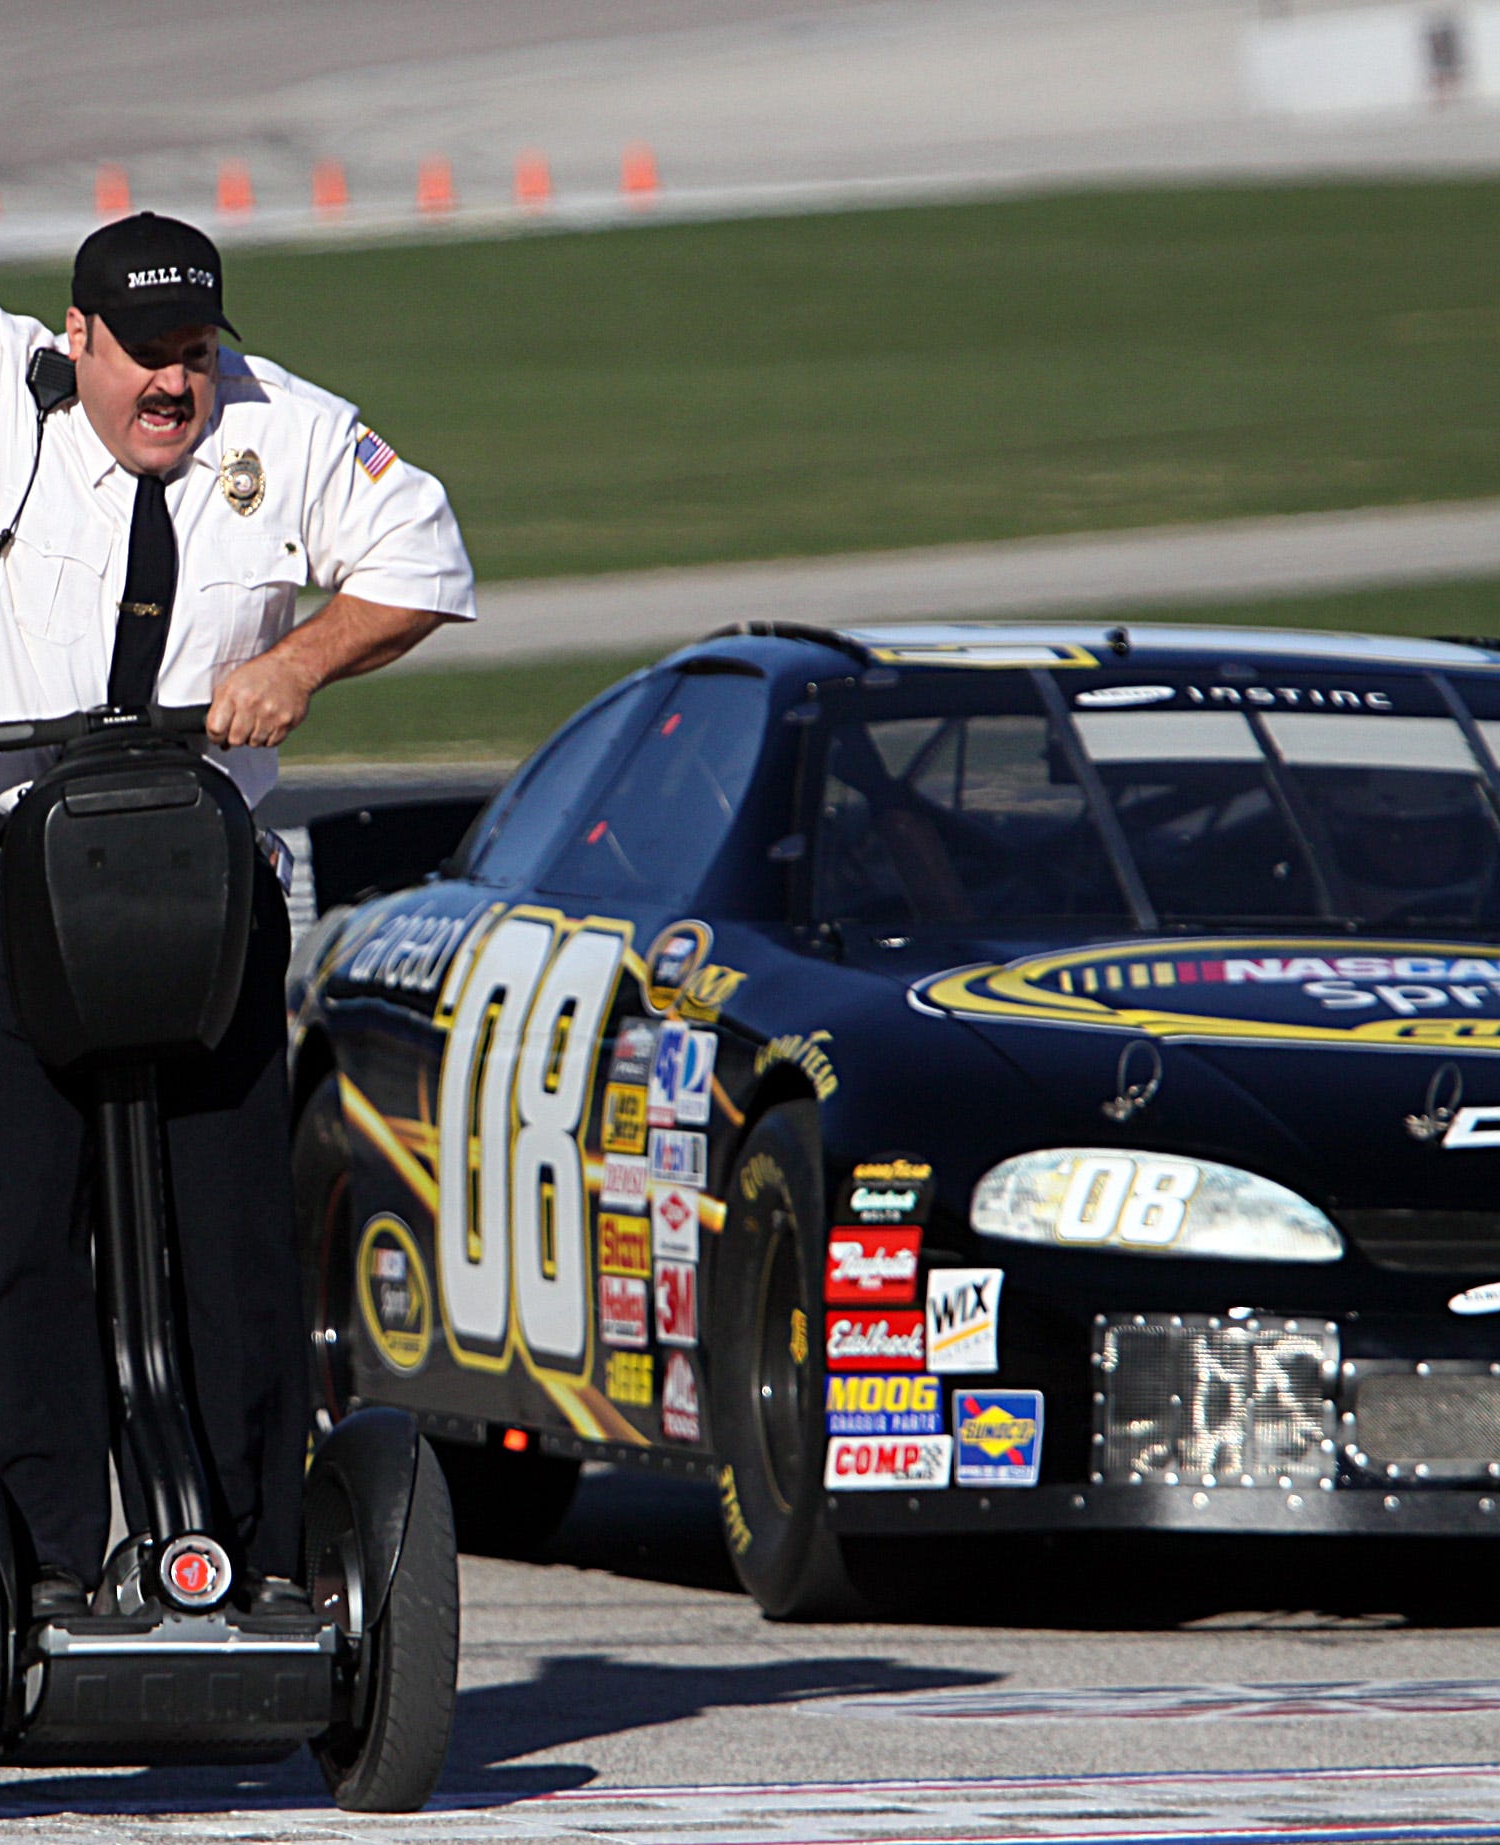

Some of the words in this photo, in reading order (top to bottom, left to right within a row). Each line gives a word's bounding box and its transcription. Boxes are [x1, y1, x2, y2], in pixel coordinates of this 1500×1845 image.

[128, 267, 182, 288] MALL
[926, 1277, 993, 1335] WIX
[827, 1320, 925, 1358] Edelbrock
[826, 1376, 939, 1412] MOOG
[966, 1421, 1032, 1440] SUNOCO
[835, 1443, 920, 1476] COMP
